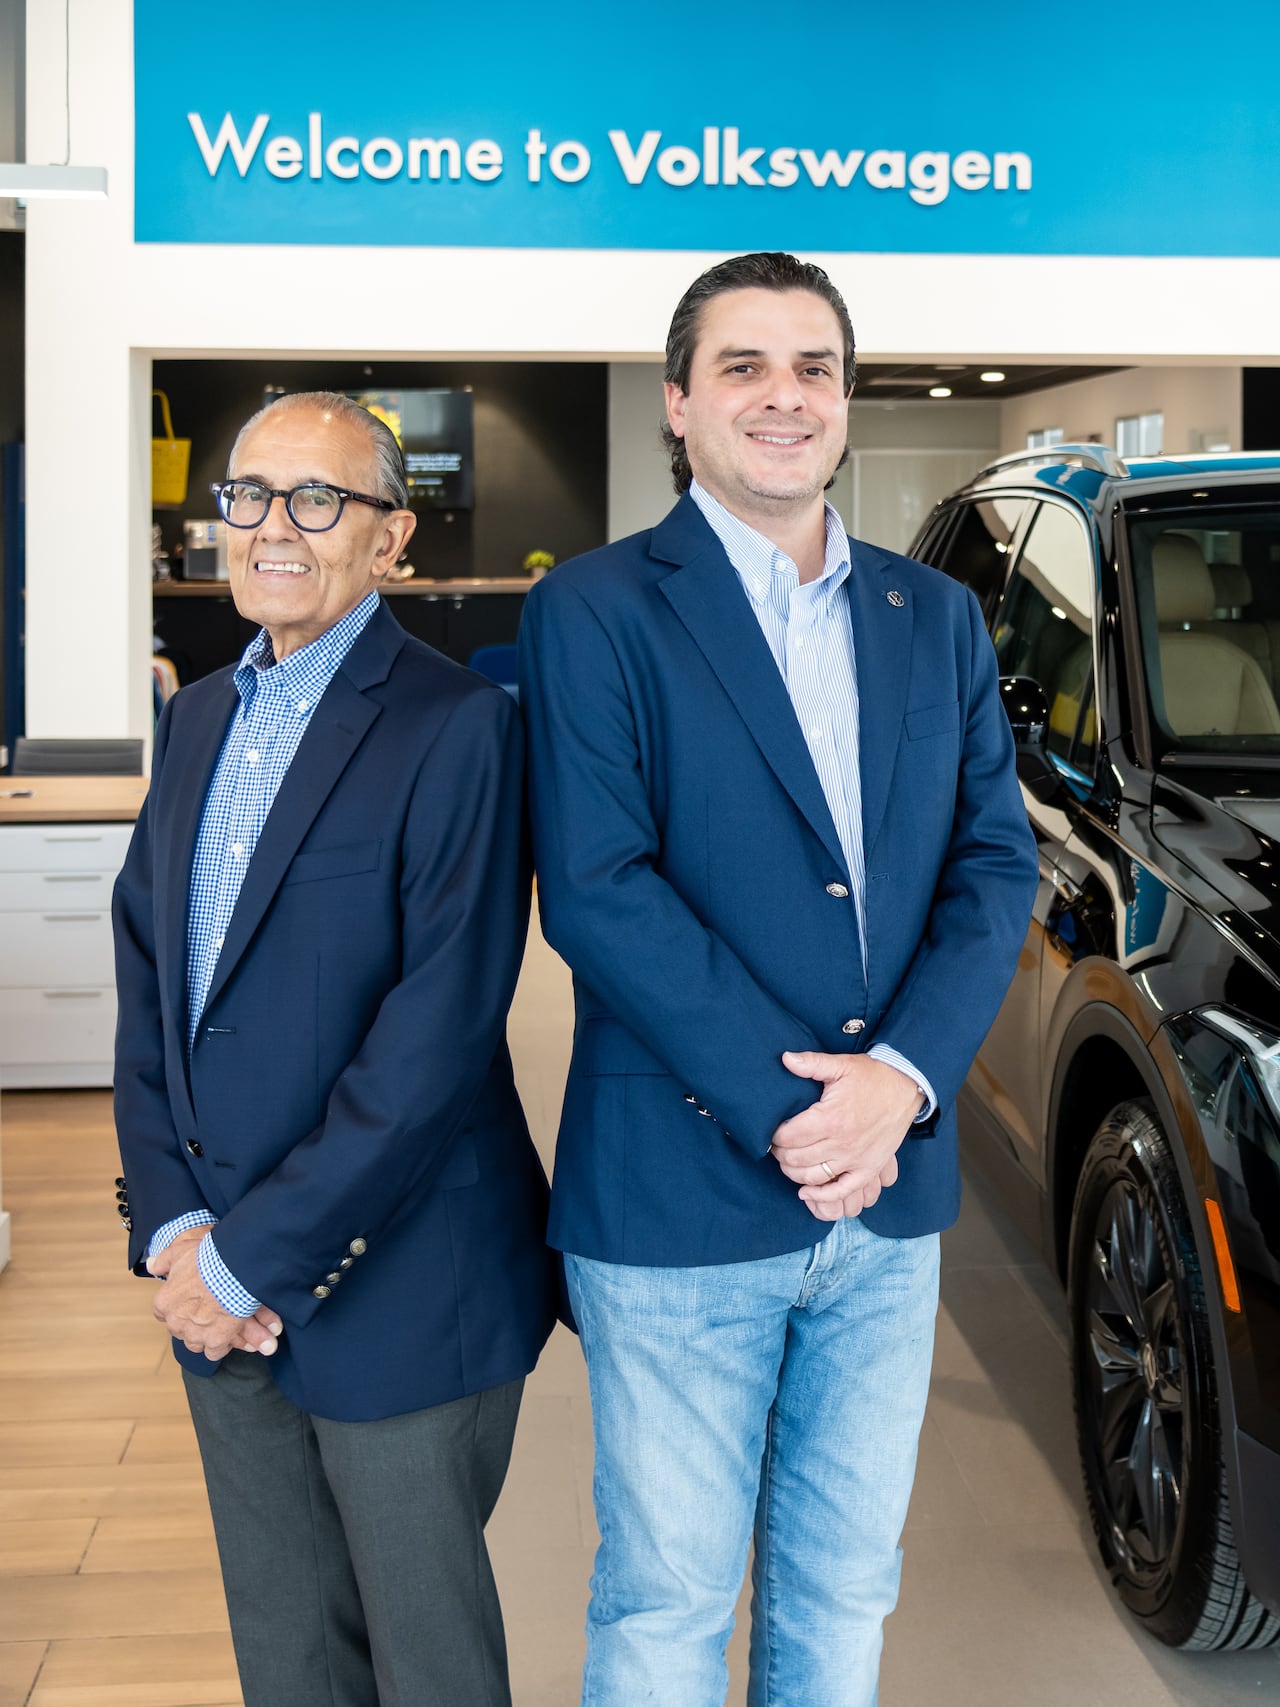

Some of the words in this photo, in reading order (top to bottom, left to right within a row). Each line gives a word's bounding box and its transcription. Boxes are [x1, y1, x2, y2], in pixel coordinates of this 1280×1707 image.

[187, 111, 502, 181] Welcome
[525, 129, 591, 182] to
[608, 127, 1032, 206] Volkswagen
